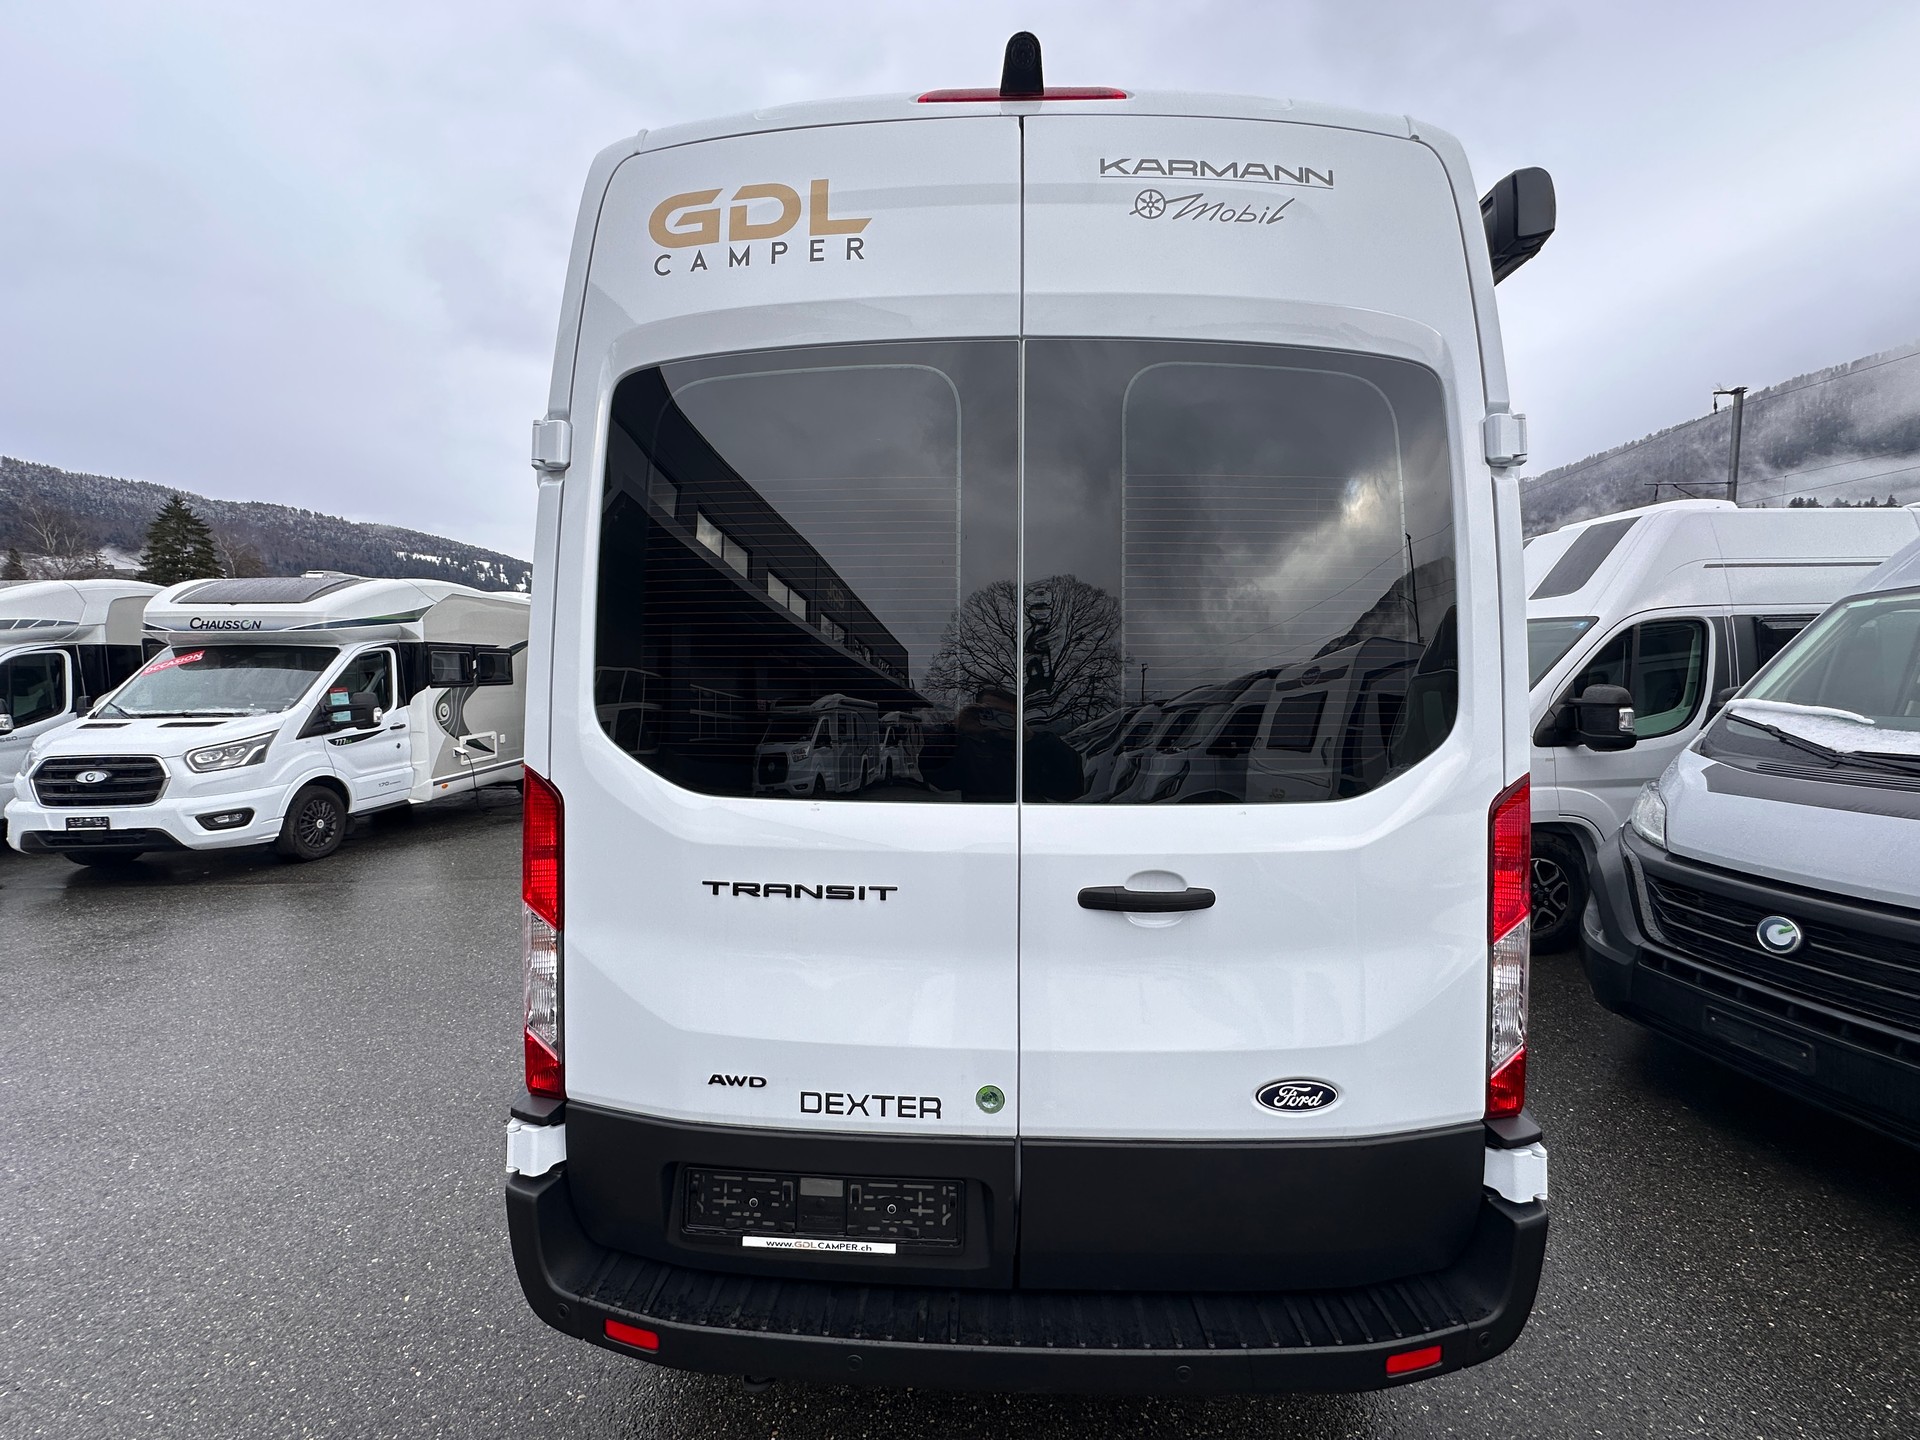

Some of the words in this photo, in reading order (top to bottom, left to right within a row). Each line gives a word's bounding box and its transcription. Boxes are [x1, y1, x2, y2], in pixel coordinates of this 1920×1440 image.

[1100, 158, 1334, 187] KARMANN
[649, 179, 872, 248] GDL
[1166, 193, 1295, 225] Mobil
[654, 237, 866, 276] CAMPER
[144, 652, 204, 675] OCCASION
[702, 880, 898, 901] TRANSIT
[708, 1074, 767, 1088] AWD
[800, 1091, 943, 1121] DEXTER
[1273, 1085, 1324, 1107] Ford
[765, 1240, 873, 1252] www.GDLCAMPER.ch
